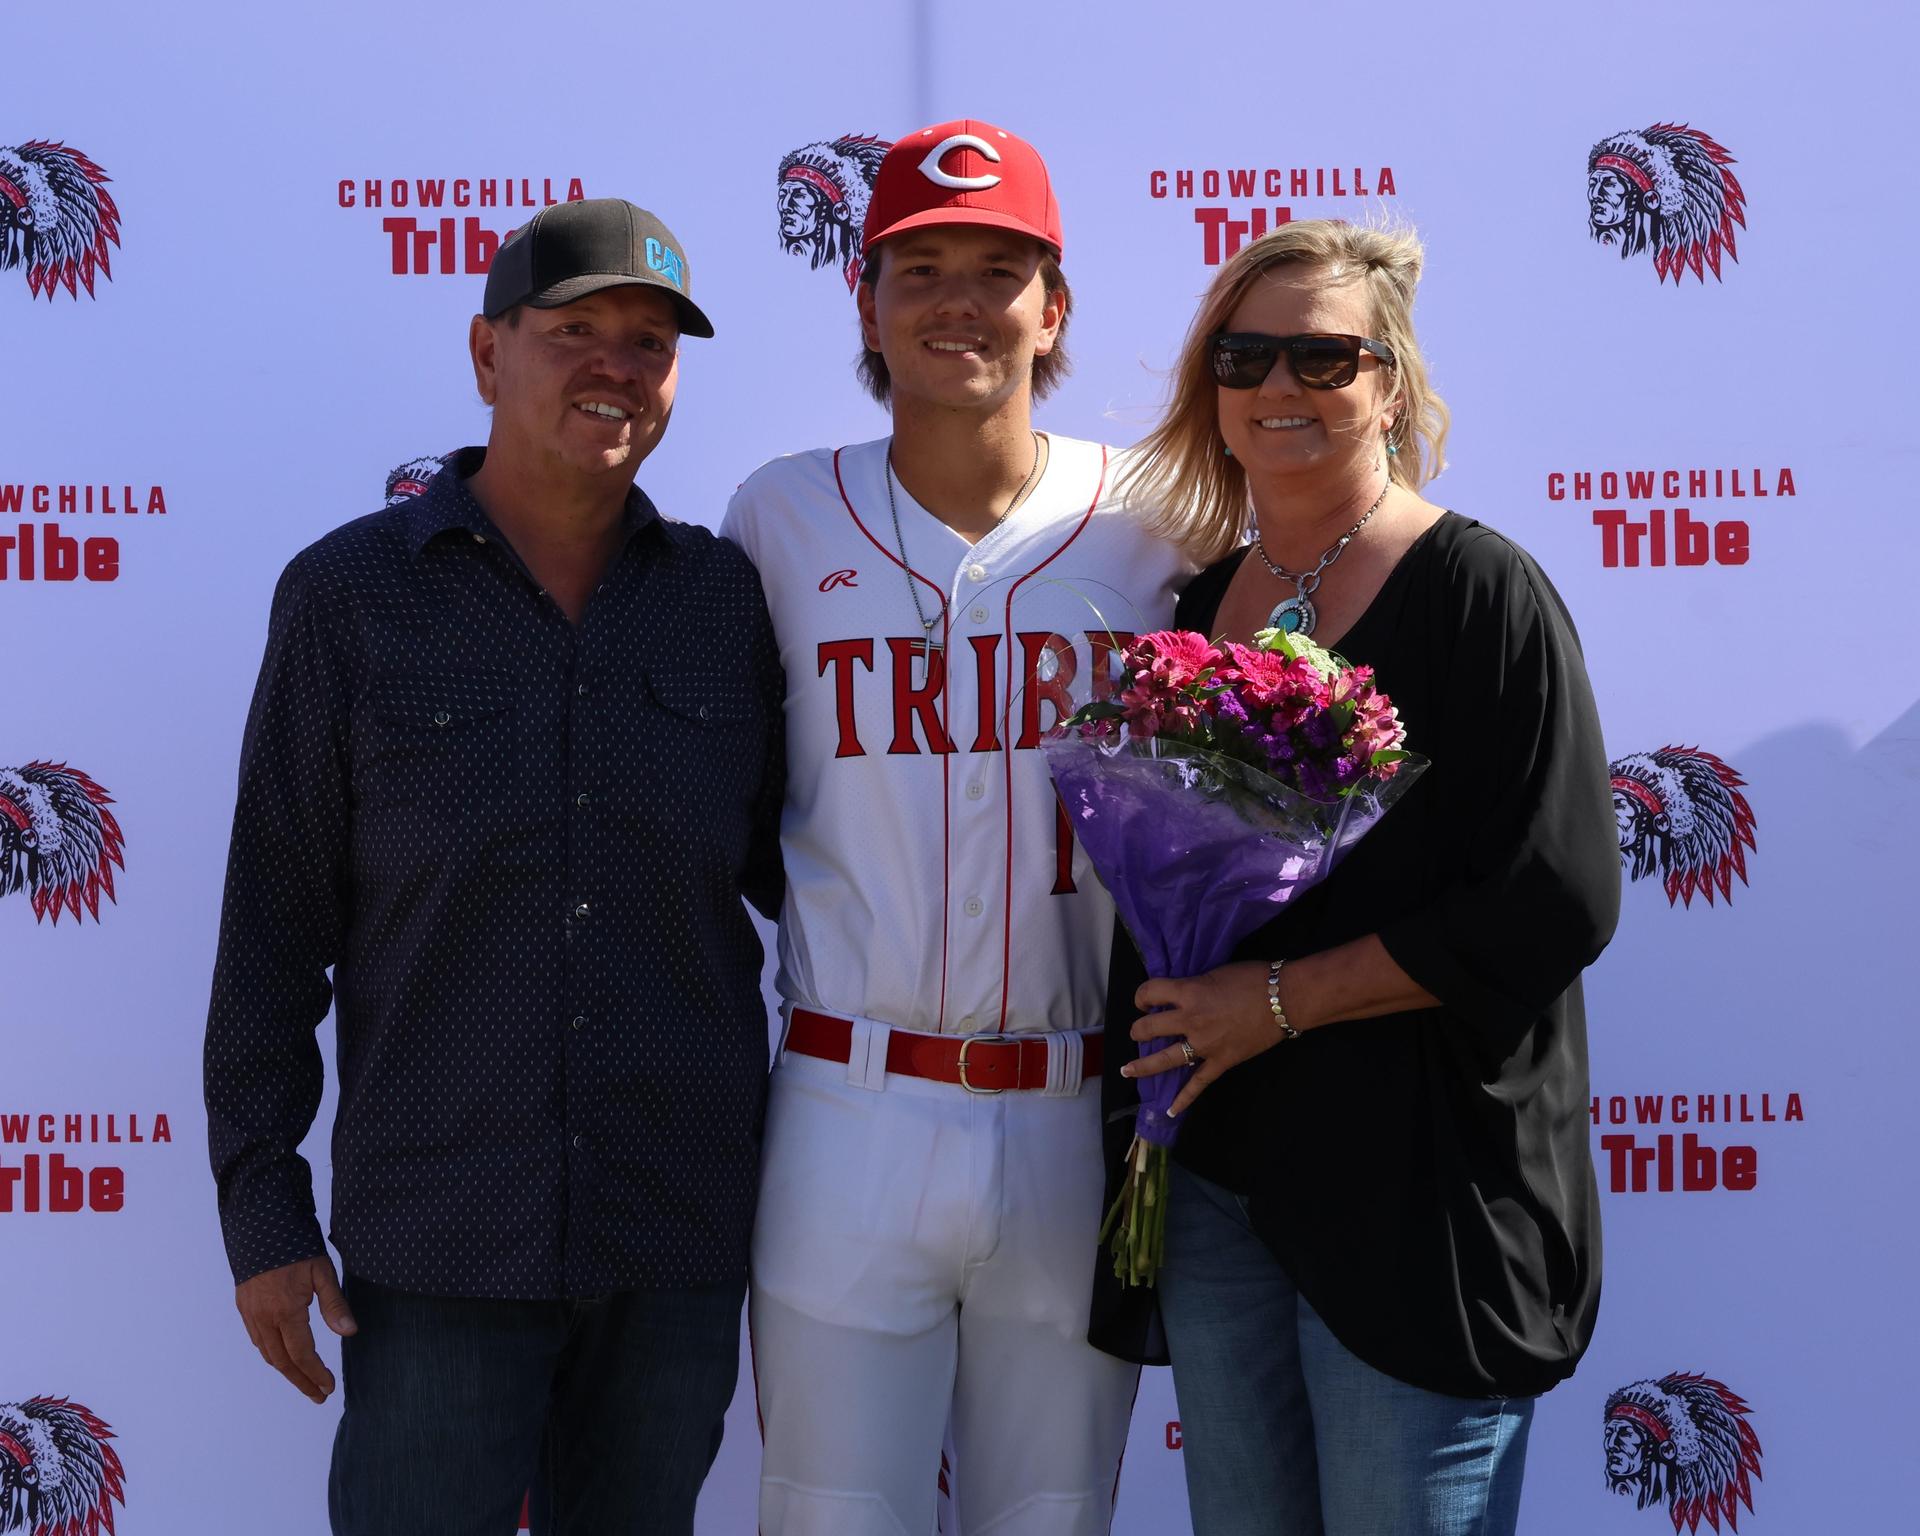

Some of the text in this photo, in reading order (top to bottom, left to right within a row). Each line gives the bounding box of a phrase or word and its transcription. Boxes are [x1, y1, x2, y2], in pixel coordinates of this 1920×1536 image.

[917, 134, 1002, 190] C
[1150, 167, 1396, 198] CHOWCHILLA
[338, 178, 585, 208] CHOWCHILLA
[383, 216, 518, 275] Trib
[645, 237, 683, 290] CAT
[1548, 468, 1796, 501] CHOWCHILLA
[1592, 508, 1750, 568] Tribe
[0, 1114, 172, 1143] WCHILLA
[0, 1153, 124, 1213] ribe
[1601, 1133, 1757, 1192] Tribe
